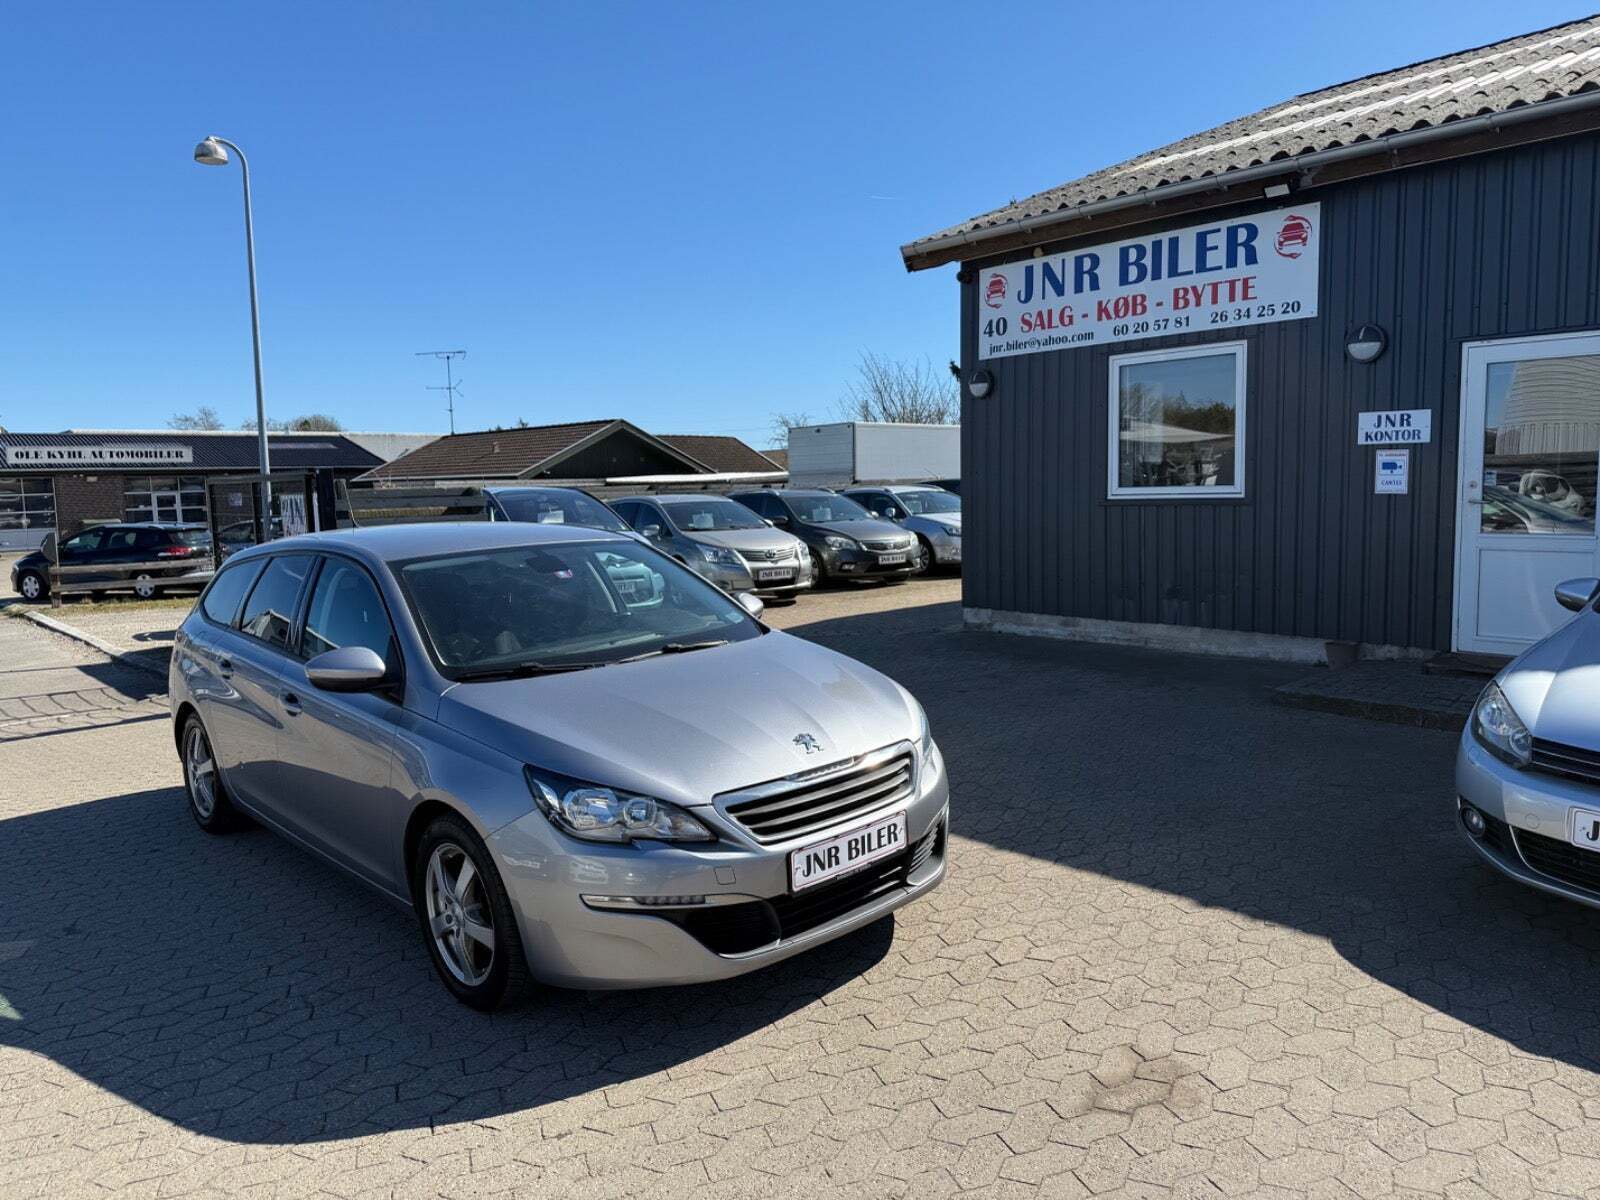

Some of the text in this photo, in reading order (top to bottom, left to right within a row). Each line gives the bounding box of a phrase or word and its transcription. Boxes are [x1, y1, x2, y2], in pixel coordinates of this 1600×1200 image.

[1017, 222, 1260, 304] JNR BILER
[1020, 305, 1074, 334] SALG
[1096, 293, 1148, 322] KØB
[1172, 276, 1258, 311] BYTTE
[1210, 300, 1301, 324] 26 34 25 20
[983, 316, 1008, 338] 40
[1113, 315, 1190, 337] 60 20 57 81
[989, 331, 1095, 356] jnr.biler@yahoo.com
[1373, 412, 1412, 428] JNR
[1364, 428, 1421, 442] KONTOR
[14, 450, 43, 460] OLE
[90, 450, 184, 460] AUTOMOBILER
[802, 822, 898, 878] JNR BILER
